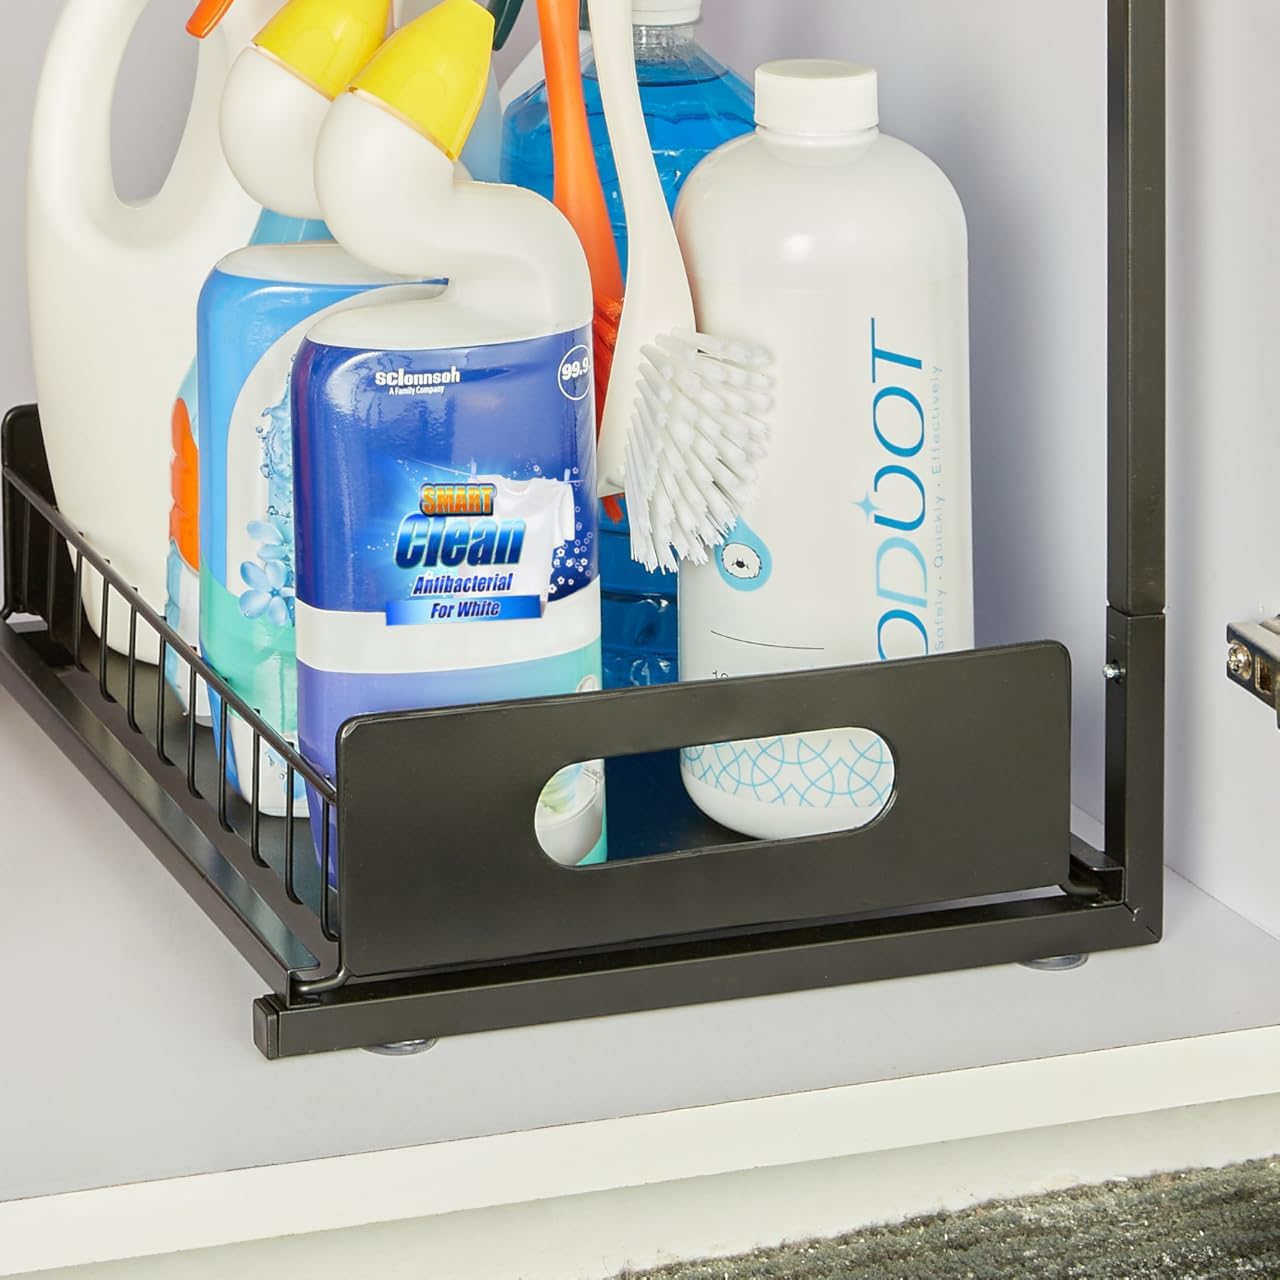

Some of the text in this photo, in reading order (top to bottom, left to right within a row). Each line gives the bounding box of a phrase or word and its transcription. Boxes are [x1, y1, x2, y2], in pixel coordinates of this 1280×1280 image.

[389, 385, 445, 396] A Family Company
[931, 365, 943, 475] Effectively
[421, 484, 494, 514] SMART
[395, 513, 527, 569] Clean
[933, 493, 948, 568] Quickly
[413, 573, 514, 595] Antibacterial
[431, 602, 500, 619] For White
